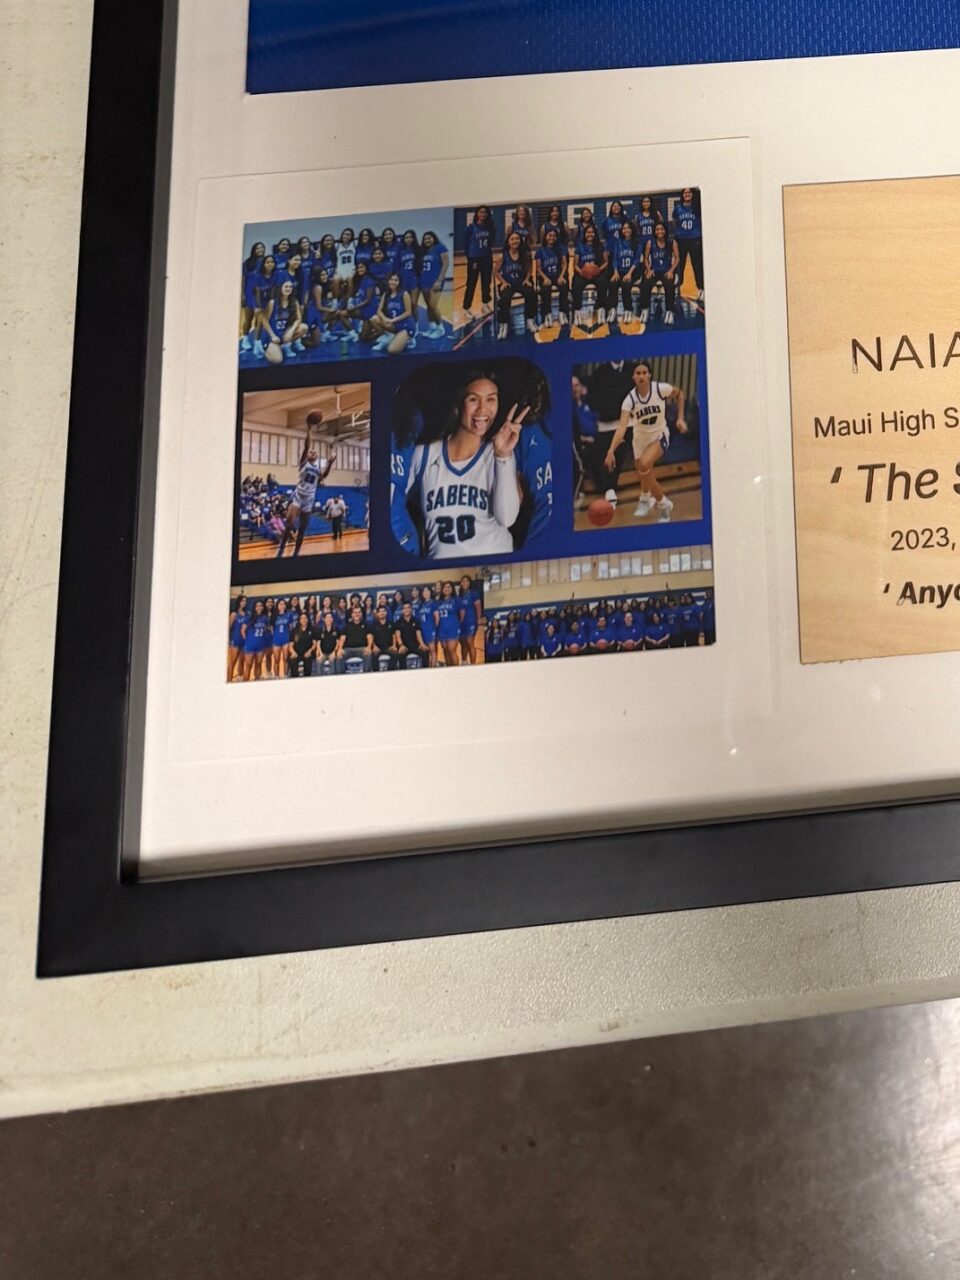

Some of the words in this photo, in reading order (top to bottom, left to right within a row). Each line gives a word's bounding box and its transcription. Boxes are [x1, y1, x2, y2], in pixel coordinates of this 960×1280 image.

[813, 412, 872, 439] Maui
[880, 408, 936, 437] High
[426, 484, 489, 513] SABERS
[435, 514, 476, 545] 20
[890, 526, 956, 552] 2023,
